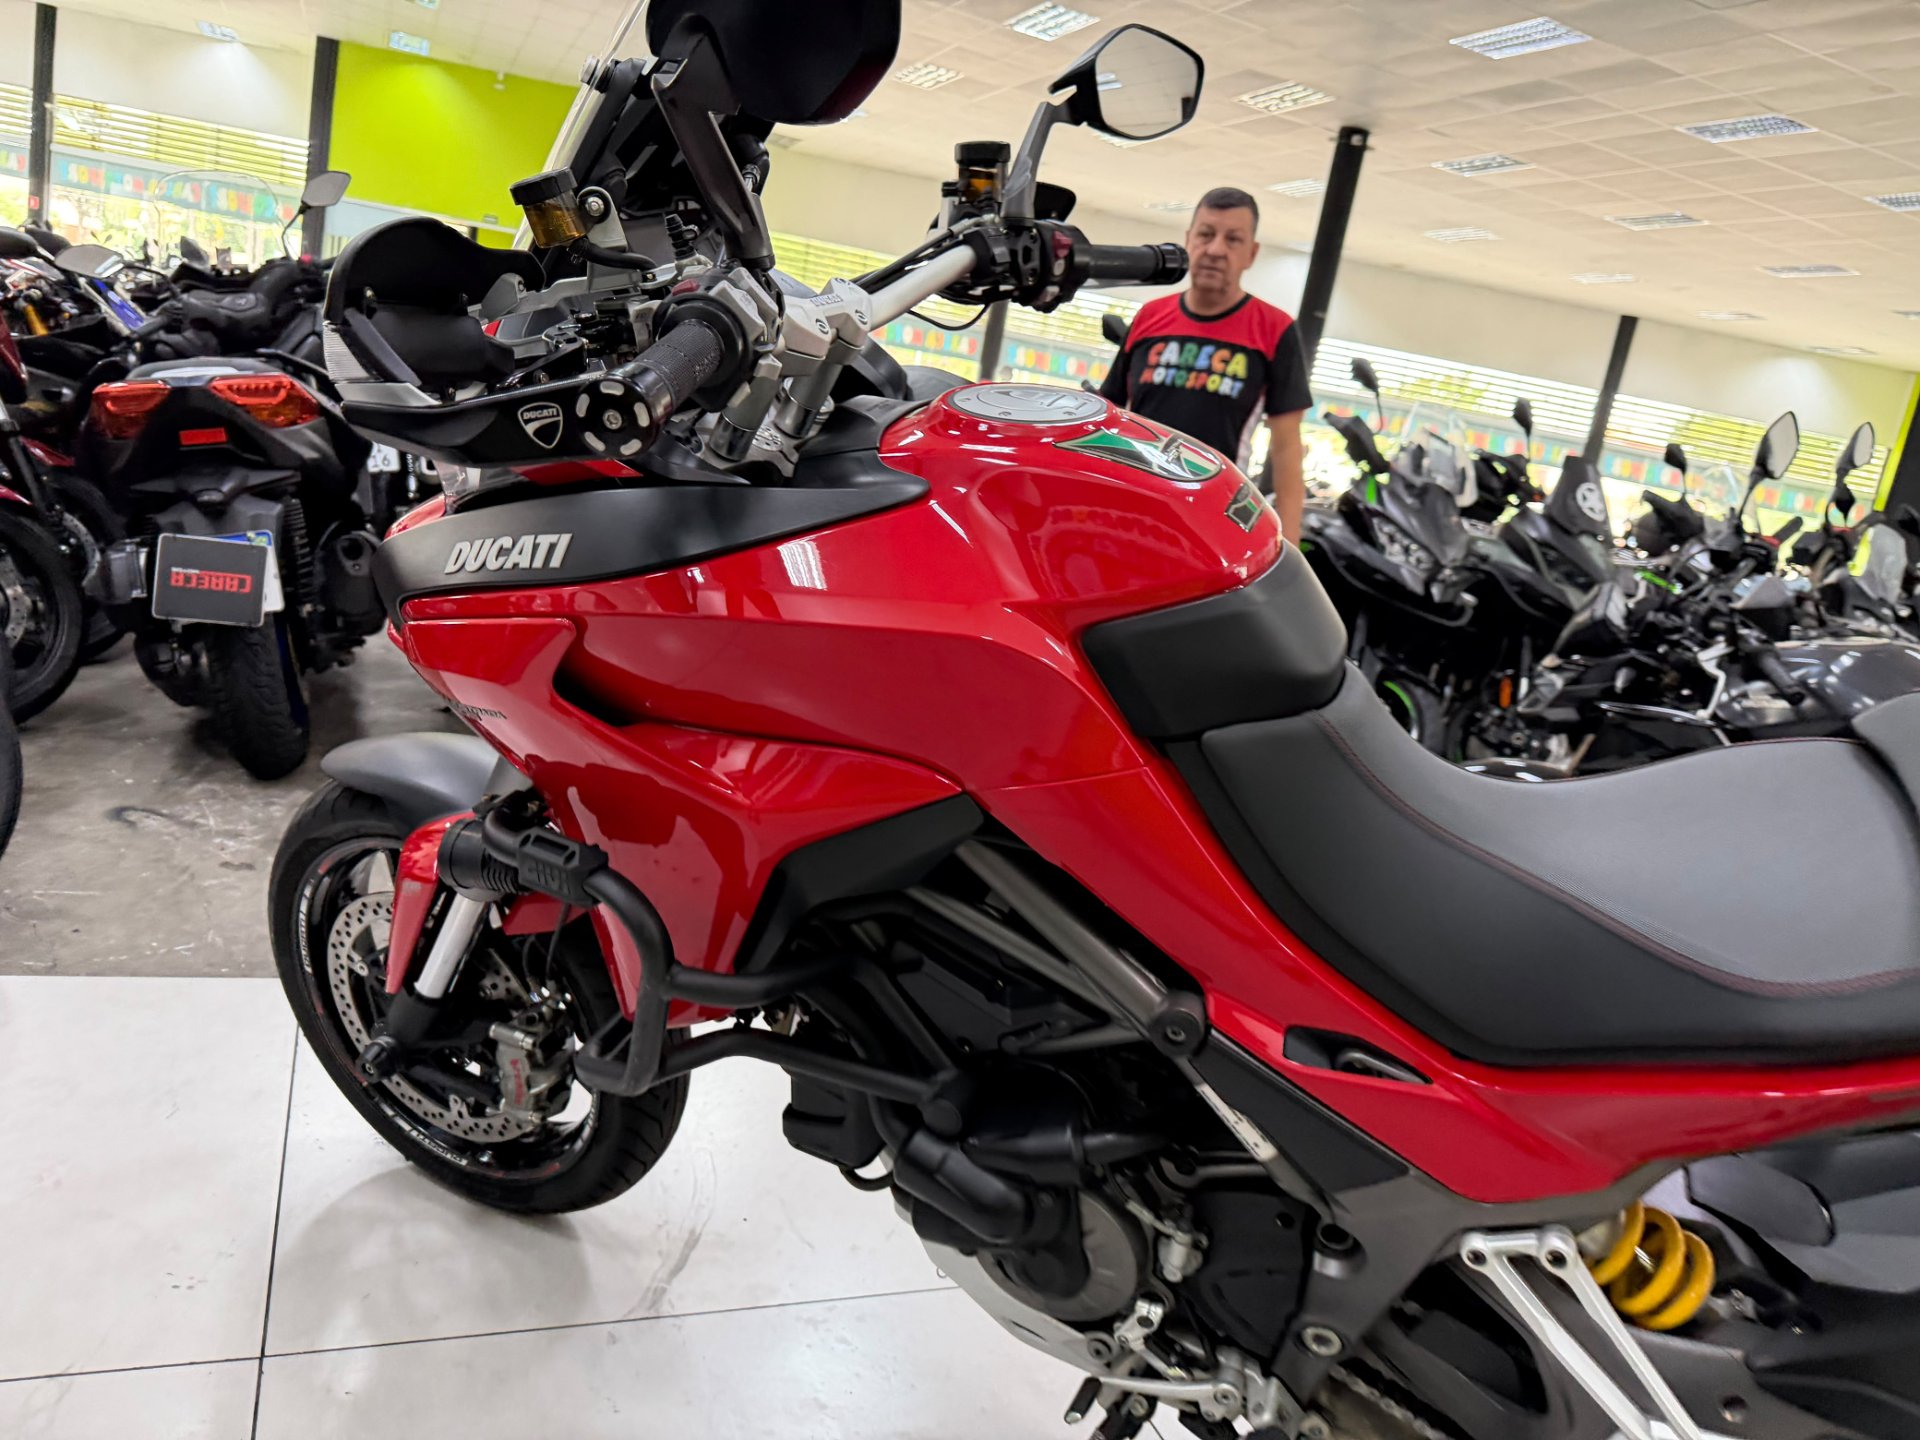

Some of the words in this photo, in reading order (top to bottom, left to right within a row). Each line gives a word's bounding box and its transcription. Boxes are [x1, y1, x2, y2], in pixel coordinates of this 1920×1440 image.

[1147, 341, 1248, 380] CARECA
[1139, 366, 1244, 399] MOTOSPORT
[523, 407, 558, 421] DUCATI
[444, 533, 573, 575] DUCATI
[169, 569, 253, 594] CARECA
